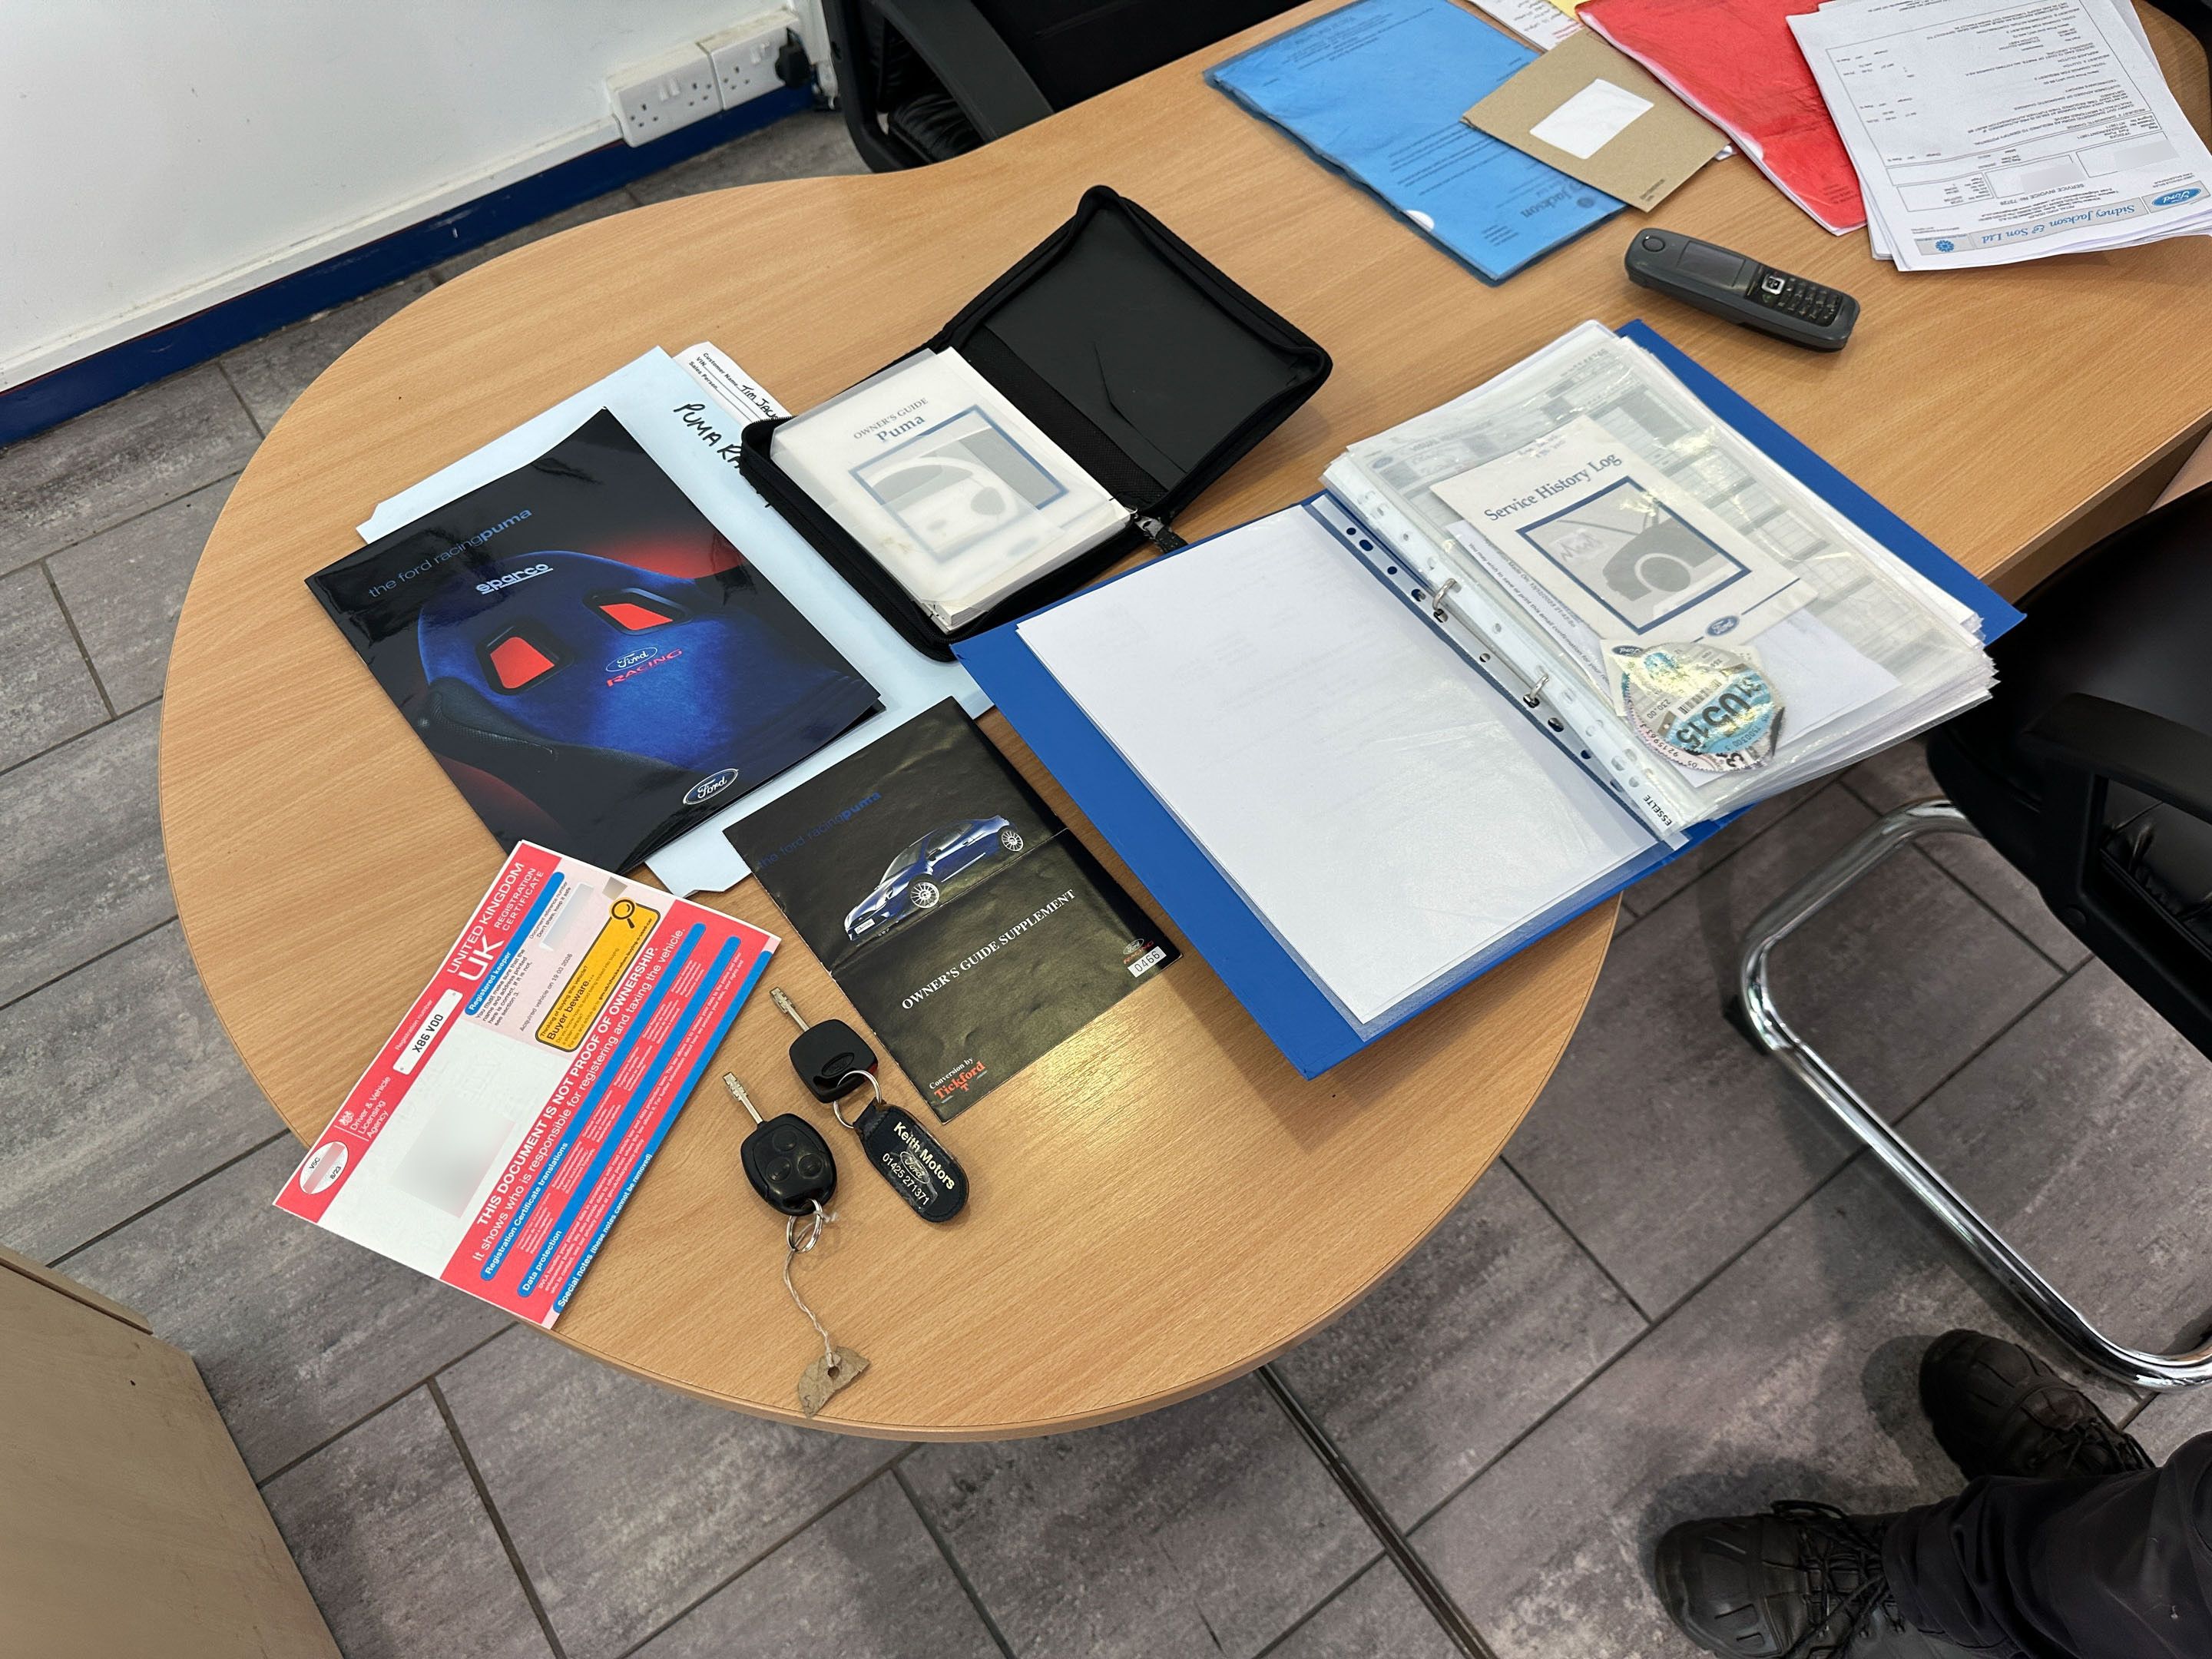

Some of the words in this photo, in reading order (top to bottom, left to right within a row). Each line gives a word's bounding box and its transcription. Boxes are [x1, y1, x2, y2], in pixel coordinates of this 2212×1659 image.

[2096, 205, 2134, 217] Sidney
[2164, 190, 2190, 204] Ford
[2006, 228, 2028, 237] Son
[2050, 210, 2092, 227] Jackson
[1982, 234, 2002, 243] Ltd
[689, 361, 702, 375] Sales
[701, 373, 718, 390] Person
[696, 356, 707, 367] VIN
[704, 353, 724, 375] Customer
[724, 373, 738, 387] Name
[673, 403, 722, 446] PUMA
[854, 414, 897, 439] OWNER'S
[898, 398, 928, 416] GUIDE
[876, 416, 926, 441] Puma
[1484, 495, 1538, 521] Service
[1535, 469, 1591, 499] History
[1588, 453, 1622, 472] Log
[369, 581, 397, 598] the
[399, 561, 432, 582] ford
[475, 563, 554, 595] sparco
[607, 648, 683, 687] RACING
[1647, 699, 1671, 719] 230.00
[1643, 794, 1672, 827] ESSELTE
[757, 853, 779, 869] the
[780, 836, 805, 856] ford
[493, 867, 537, 928] REGISTRATION
[502, 870, 545, 932] CERTIFICATE
[446, 925, 485, 974] UNITED
[478, 862, 525, 924] KINGDOM
[457, 933, 505, 982] UK
[655, 926, 686, 964] vehicle.
[902, 967, 960, 1009] OWNER'S
[960, 941, 1000, 971] GUIDE
[998, 889, 1076, 945] SUPPLEMENT
[1134, 951, 1160, 972] 0466
[469, 974, 498, 1011] Registered
[492, 951, 514, 975] keeper
[475, 1008, 487, 1019] You
[482, 995, 495, 1008] must
[491, 979, 505, 995] make
[502, 968, 513, 980] sure
[508, 957, 520, 969] that
[516, 948, 526, 958] the
[481, 1006, 495, 1022] name
[492, 995, 502, 1006] and
[498, 974, 516, 995] address
[512, 956, 528, 975] printed
[644, 963, 663, 982] the
[518, 1007, 538, 1031] Acquired
[533, 988, 550, 1008] vehicle
[545, 981, 555, 989] on
[560, 952, 574, 966] 2026
[545, 1013, 570, 1041] Buyer
[563, 972, 596, 1013] beware...
[624, 981, 652, 1014] taxing
[393, 1016, 421, 1051] Registration
[416, 998, 433, 1017] number
[611, 1013, 632, 1035] and
[577, 1035, 619, 1091] registering
[929, 1063, 965, 1089] Conversion
[963, 1057, 974, 1065] by
[475, 1194, 503, 1227] THIS
[496, 1119, 549, 1194] DOCUMENT
[543, 1105, 558, 1119] IS
[551, 1077, 576, 1105] NOT
[569, 1034, 603, 1077] PROOF
[596, 1015, 614, 1034] OF
[608, 945, 658, 1015] OWNERSHIP.
[933, 1061, 986, 1099] Tickford
[349, 1108, 369, 1131] Driver
[369, 1075, 392, 1101] Vehicle
[566, 1091, 584, 1108] for
[357, 1099, 386, 1134] Licensing
[366, 1109, 390, 1138] Agency
[526, 1108, 574, 1173] responsible
[893, 1121, 921, 1153] Keith
[919, 1148, 955, 1190] Motors
[308, 1156, 321, 1170] V5C
[328, 1164, 342, 1179] 8/23
[630, 1152, 654, 1183] removed)
[882, 1153, 906, 1177] 01425
[902, 1175, 930, 1205] 271371
[502, 1184, 527, 1211] who
[611, 1190, 631, 1214] cannot
[624, 1181, 637, 1192] be
[483, 1225, 518, 1274] Registration
[512, 1185, 543, 1227] Certificate
[536, 1141, 569, 1186] translations
[601, 1213, 618, 1233] notes
[478, 1210, 510, 1250] shows
[588, 1232, 608, 1254] (these
[472, 1250, 485, 1261] It
[521, 1270, 539, 1291] Data
[533, 1229, 563, 1270] protection
[575, 1253, 594, 1277] notes
[556, 1277, 581, 1307] Special
